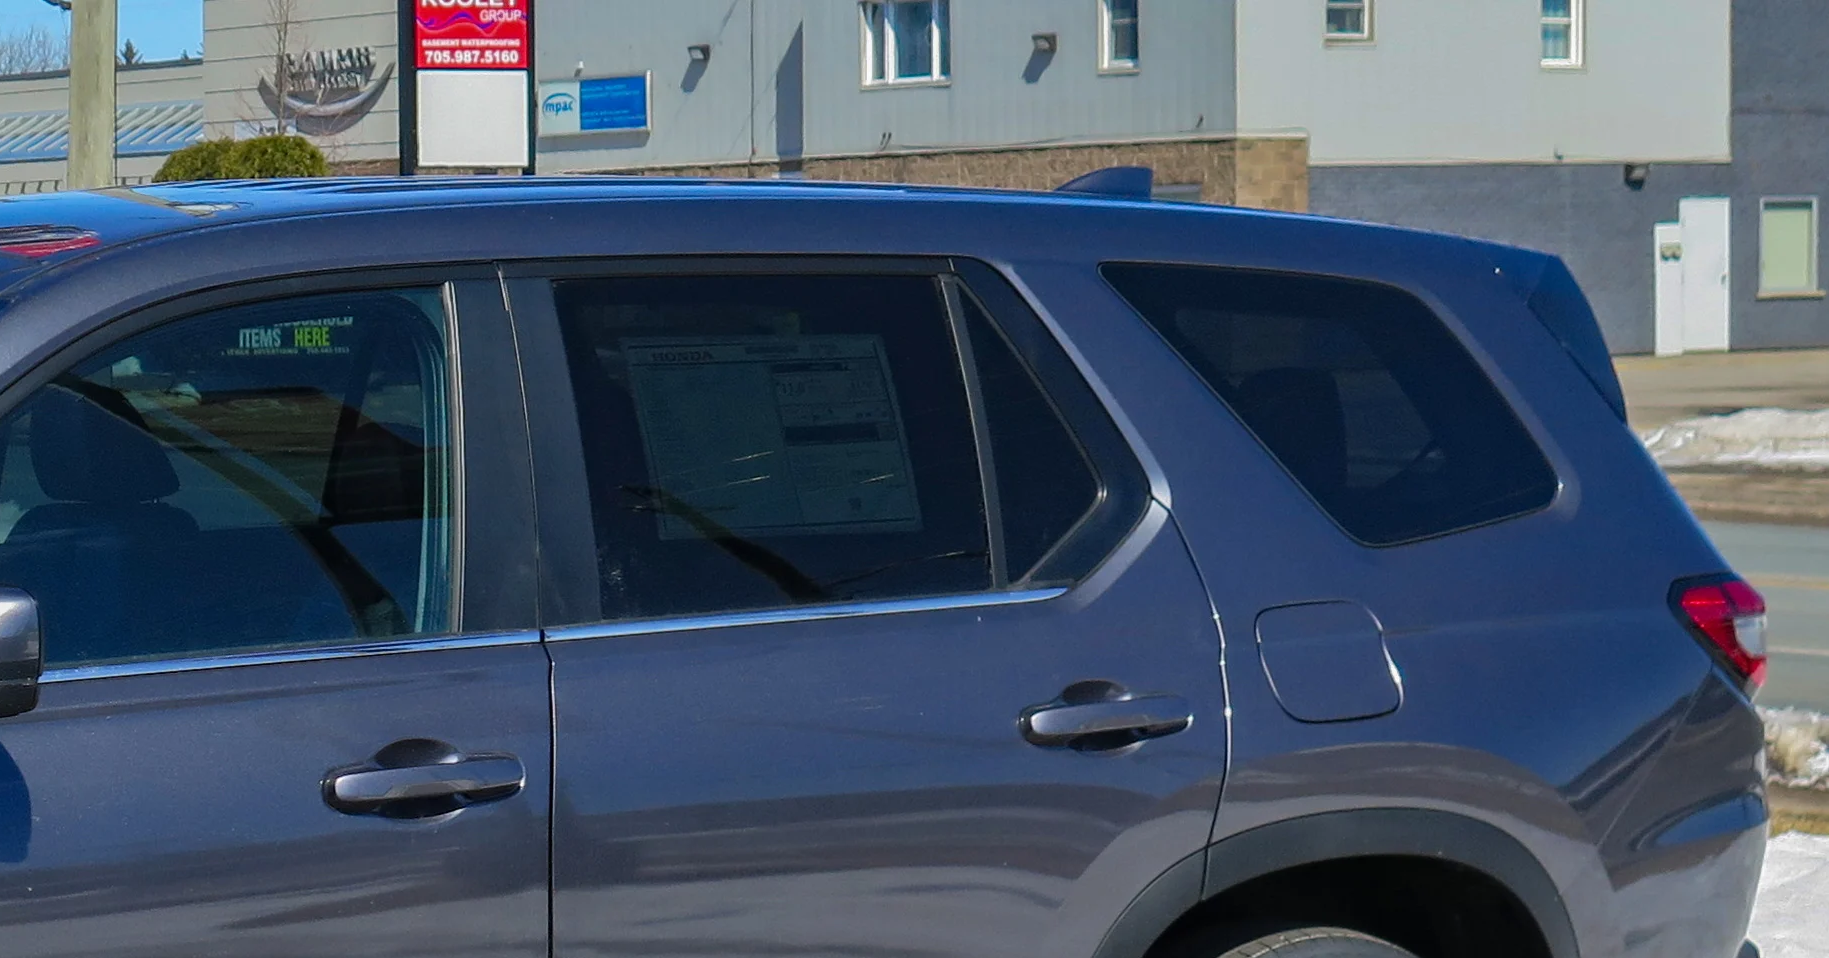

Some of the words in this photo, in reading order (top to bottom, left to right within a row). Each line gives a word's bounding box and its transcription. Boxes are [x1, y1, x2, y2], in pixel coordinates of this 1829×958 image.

[479, 9, 522, 22] GROUP
[421, 38, 460, 47] BASEMENT
[461, 38, 521, 47] WATERPROOFING
[424, 50, 519, 64] 705.987.5160
[544, 100, 574, 116] mpac
[238, 328, 282, 348] ITEMS
[294, 326, 331, 348] HERE
[651, 350, 714, 362] HONDA
